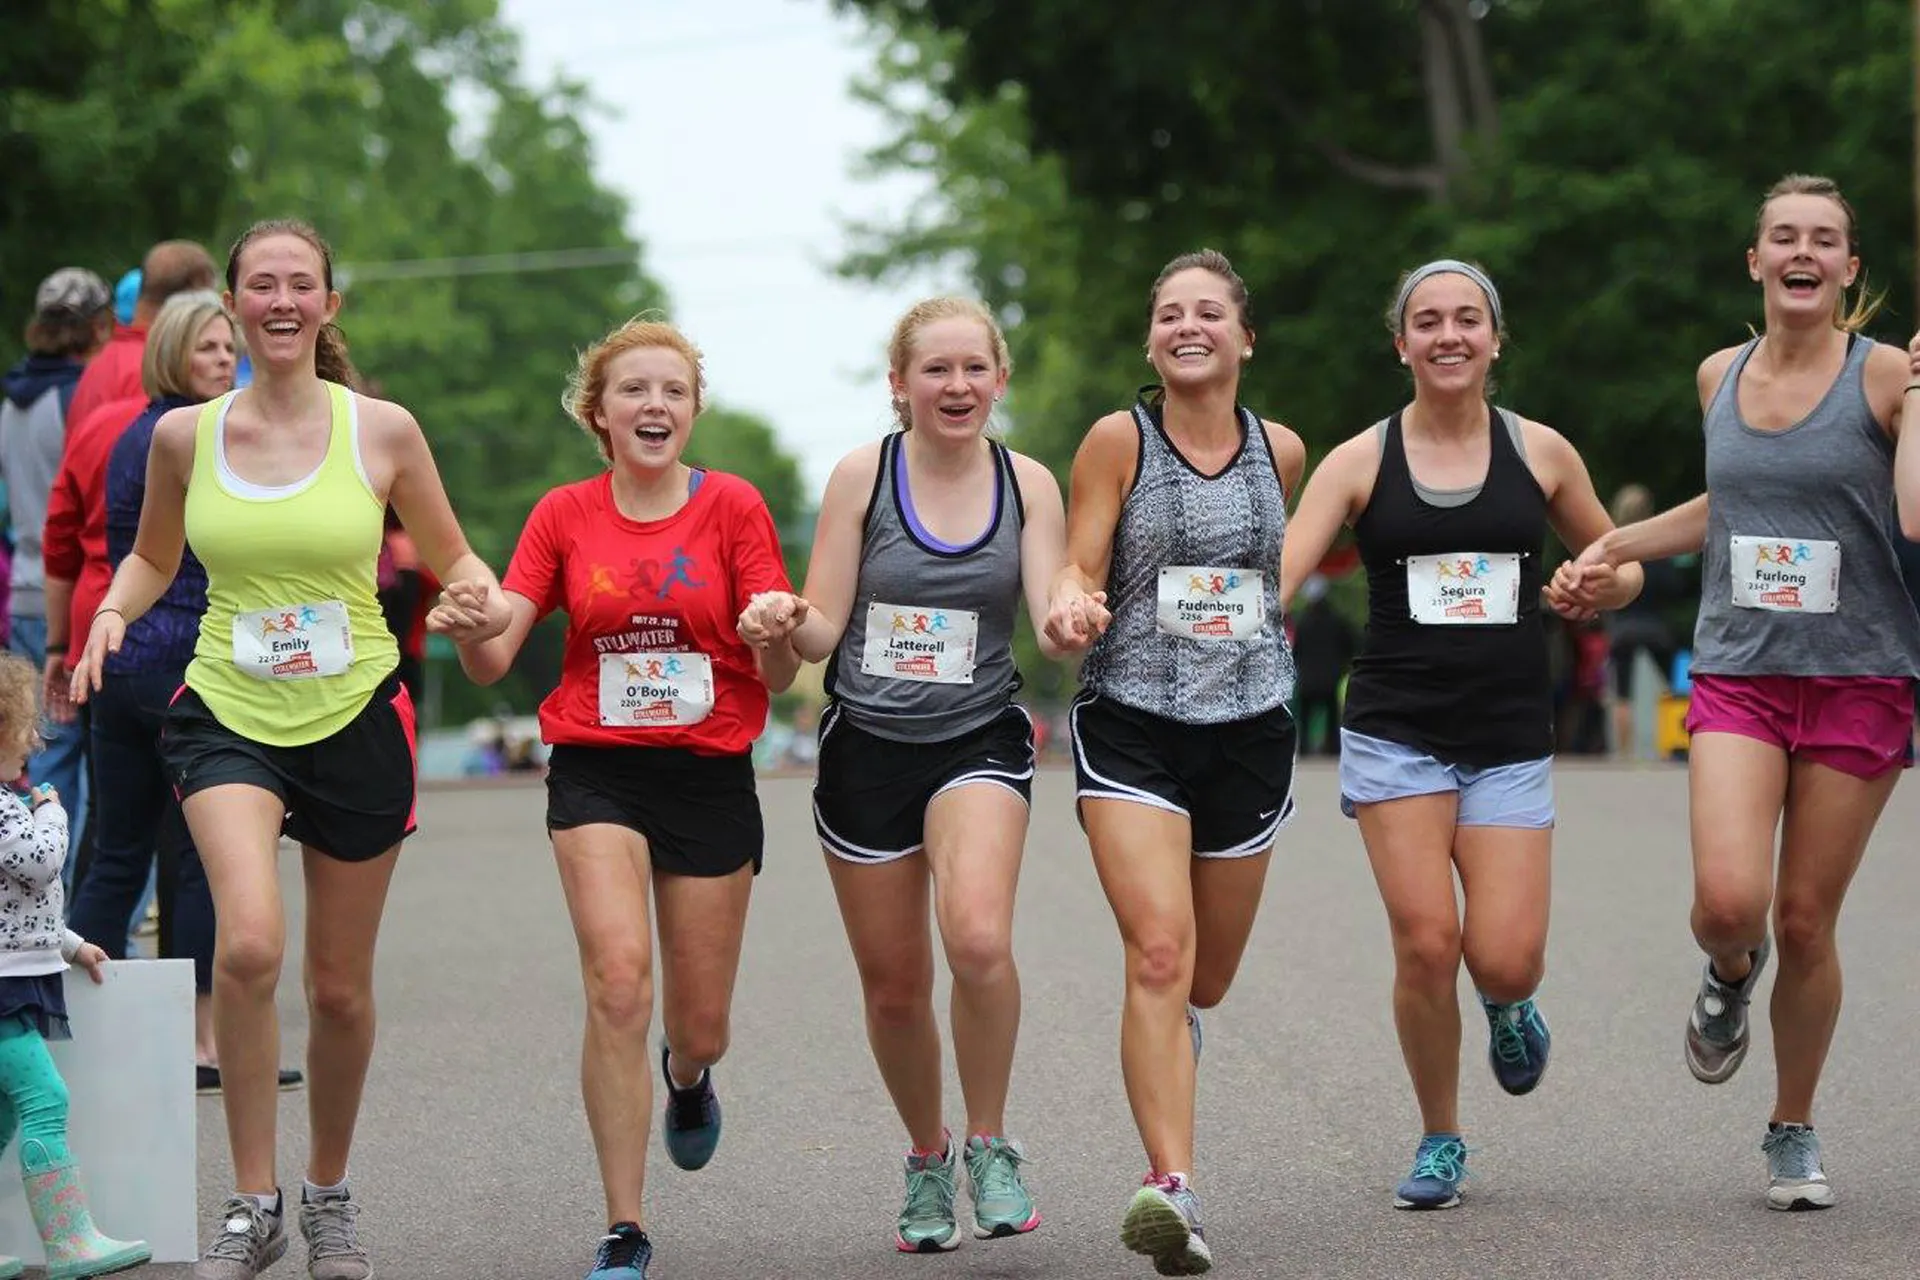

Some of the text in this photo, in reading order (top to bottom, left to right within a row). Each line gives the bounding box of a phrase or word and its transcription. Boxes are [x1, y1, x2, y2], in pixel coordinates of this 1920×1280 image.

[1756, 570, 1807, 586] Furlong
[1440, 586, 1486, 598] Segura
[1177, 599, 1244, 615] Fudenberg
[1180, 613, 1203, 621] 2256
[272, 638, 310, 653] Emily
[594, 629, 676, 653] STILLWATER
[889, 638, 945, 653] Latterell
[883, 650, 905, 659] 2136
[626, 686, 680, 699] O'Boyle
[620, 699, 642, 708] 2205
